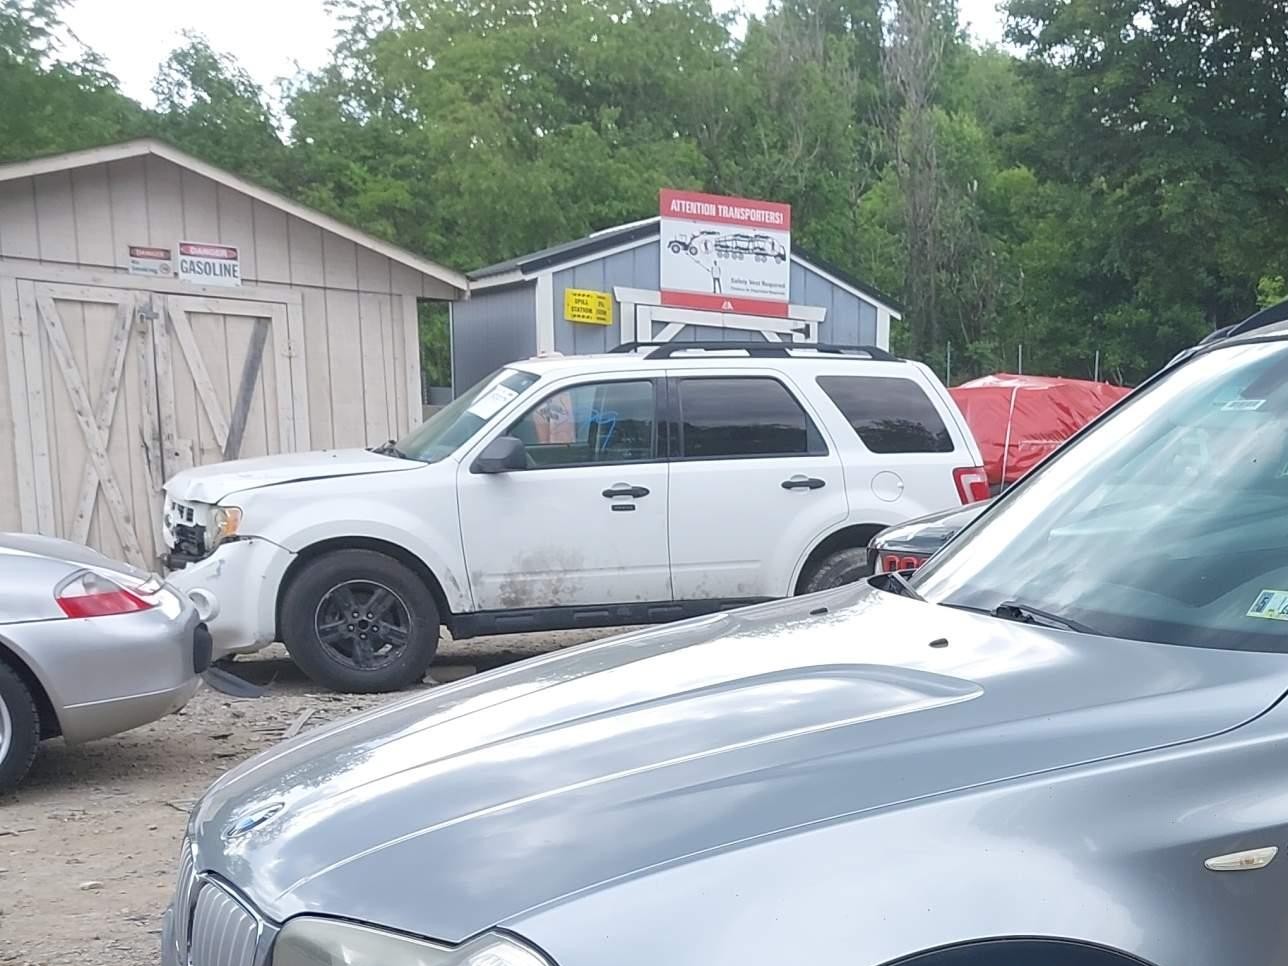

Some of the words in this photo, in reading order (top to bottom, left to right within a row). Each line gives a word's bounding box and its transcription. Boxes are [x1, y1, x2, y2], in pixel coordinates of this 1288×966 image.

[671, 199, 716, 216] ATTENTION
[718, 205, 784, 225] TRANSPORTERS!
[180, 259, 239, 278] GASOLINE
